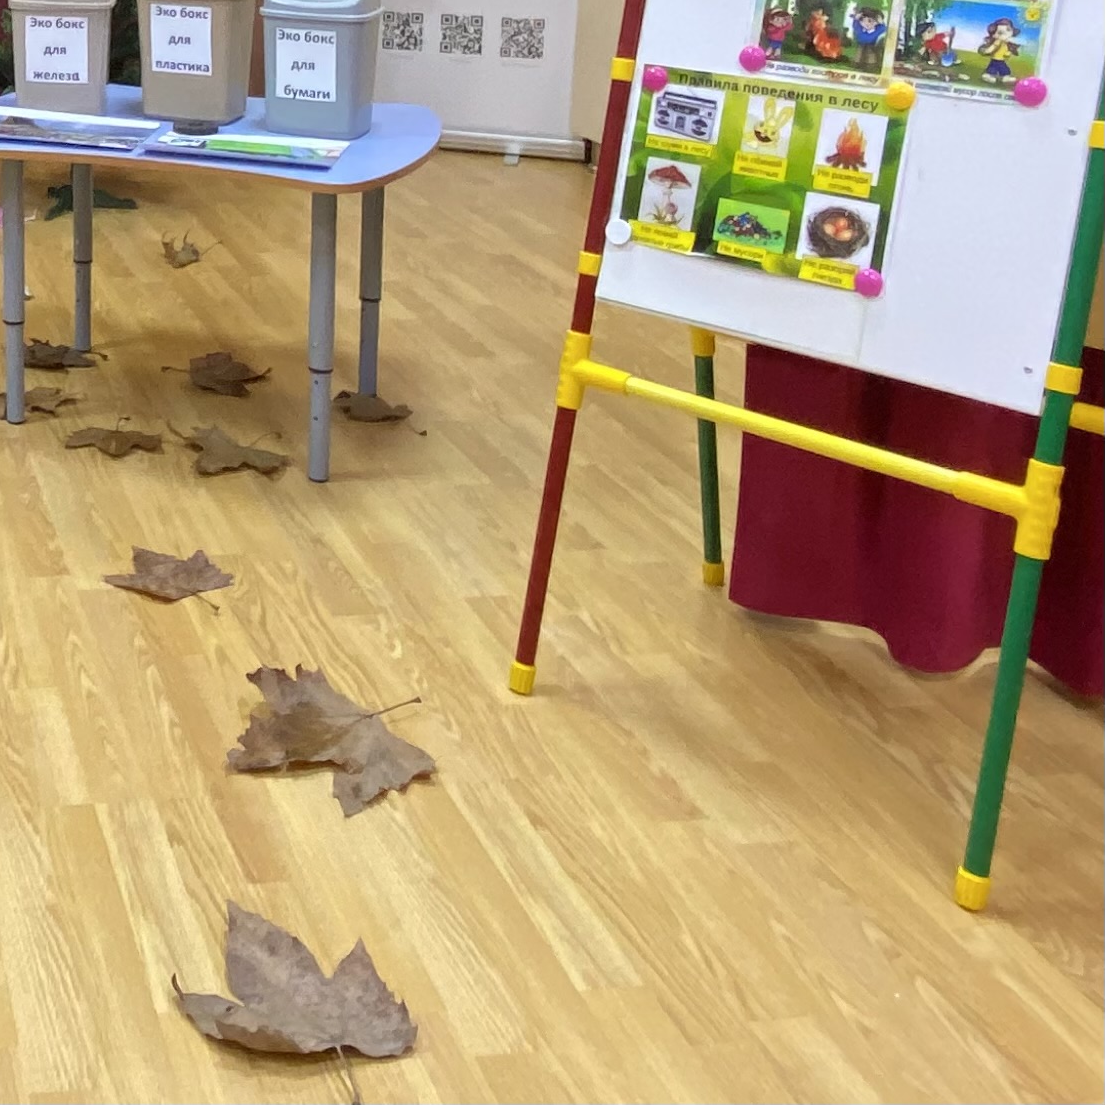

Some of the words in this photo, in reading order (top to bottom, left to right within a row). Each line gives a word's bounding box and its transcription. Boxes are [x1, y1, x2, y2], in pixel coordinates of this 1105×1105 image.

[155, 5, 177, 17] Эко
[180, 7, 209, 19] бокс
[29, 17, 52, 28] Эко
[55, 17, 85, 29] бокс
[168, 35, 191, 46] для
[277, 29, 301, 42] Эко
[304, 31, 335, 44] бокс
[43, 46, 67, 56] для
[155, 60, 210, 73] пластика
[290, 60, 315, 72] для
[33, 71, 80, 81] железа
[283, 84, 331, 100] бумаги
[677, 73, 739, 93] Правила
[743, 83, 823, 104] поведения
[828, 96, 837, 105] в
[841, 97, 880, 113] лесу
